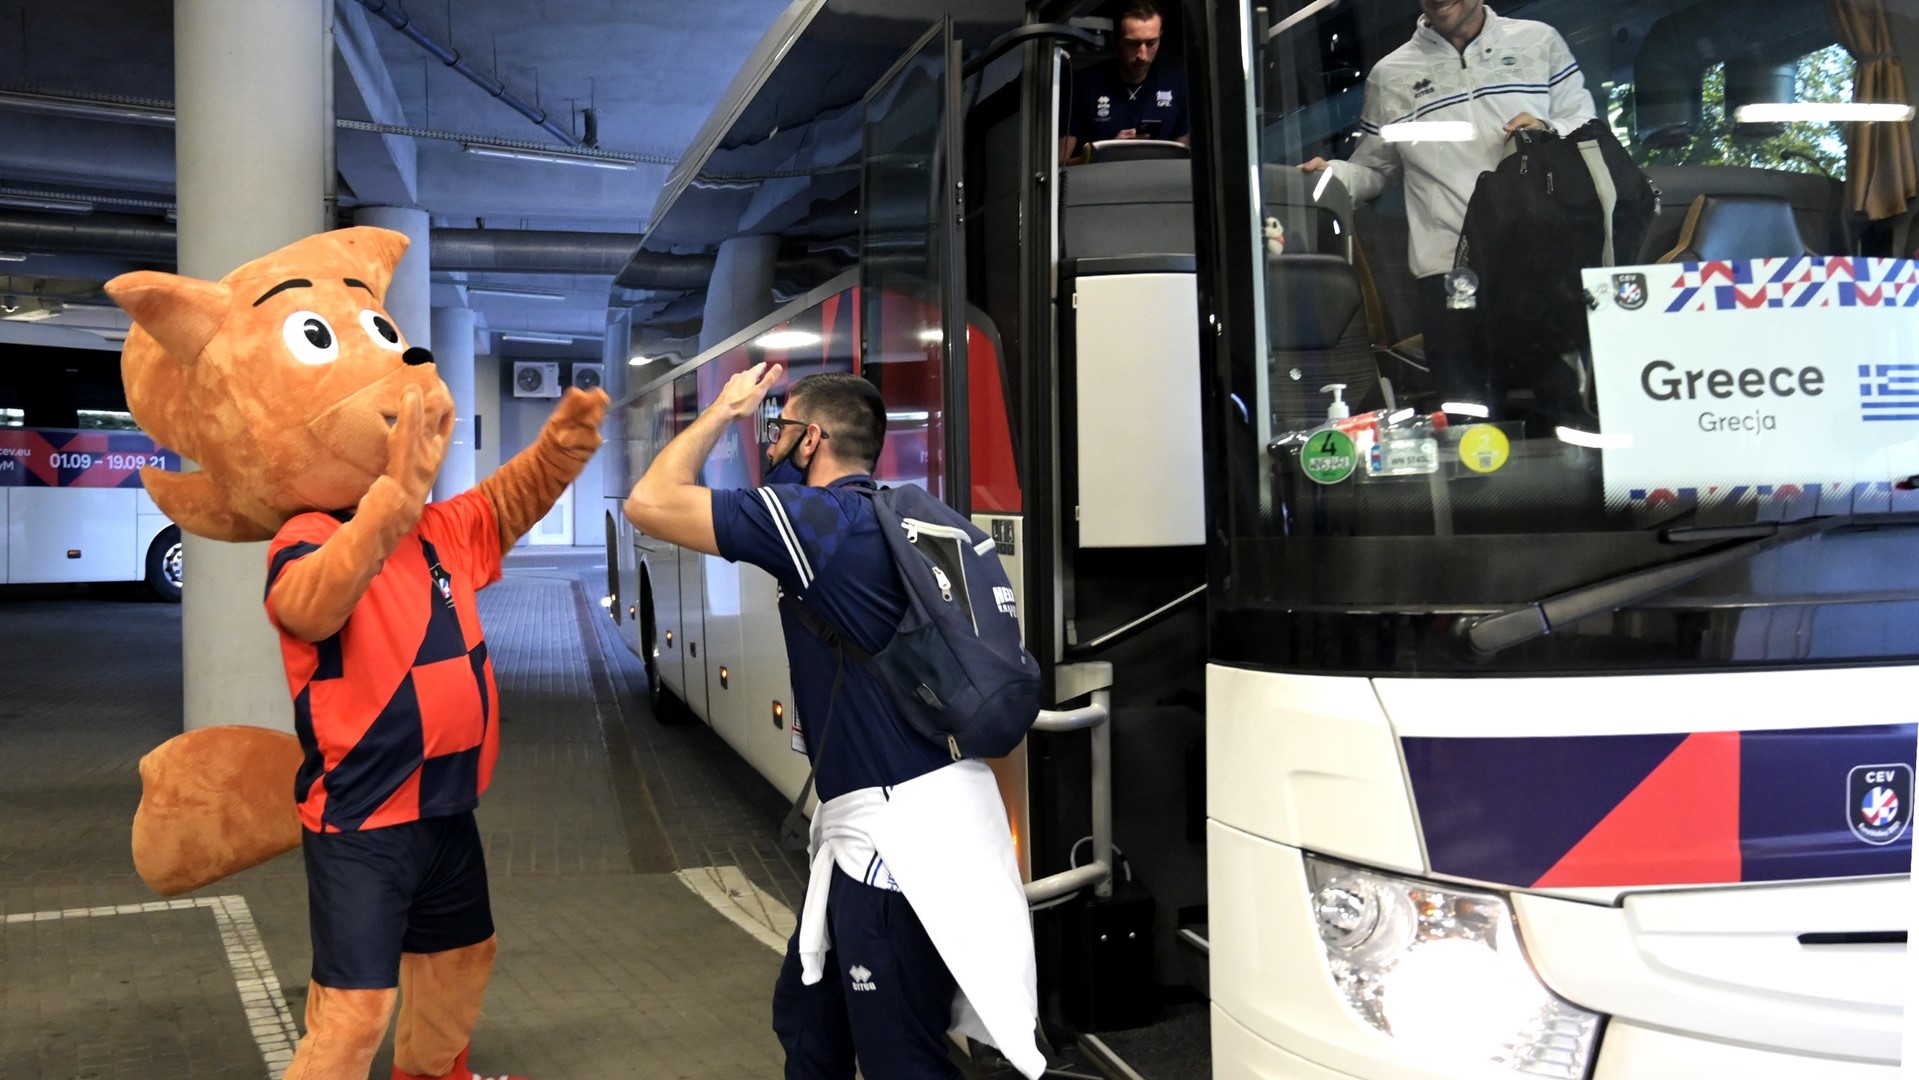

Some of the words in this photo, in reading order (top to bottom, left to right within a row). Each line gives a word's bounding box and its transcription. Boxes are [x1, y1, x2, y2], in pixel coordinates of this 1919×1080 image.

[1641, 360, 1825, 401] Greece
[1698, 409, 1777, 435] Grecja
[1321, 432, 1337, 456] 4
[49, 453, 91, 469] 01.09
[106, 454, 166, 470] 19.0921
[1865, 770, 1895, 783] CEV
